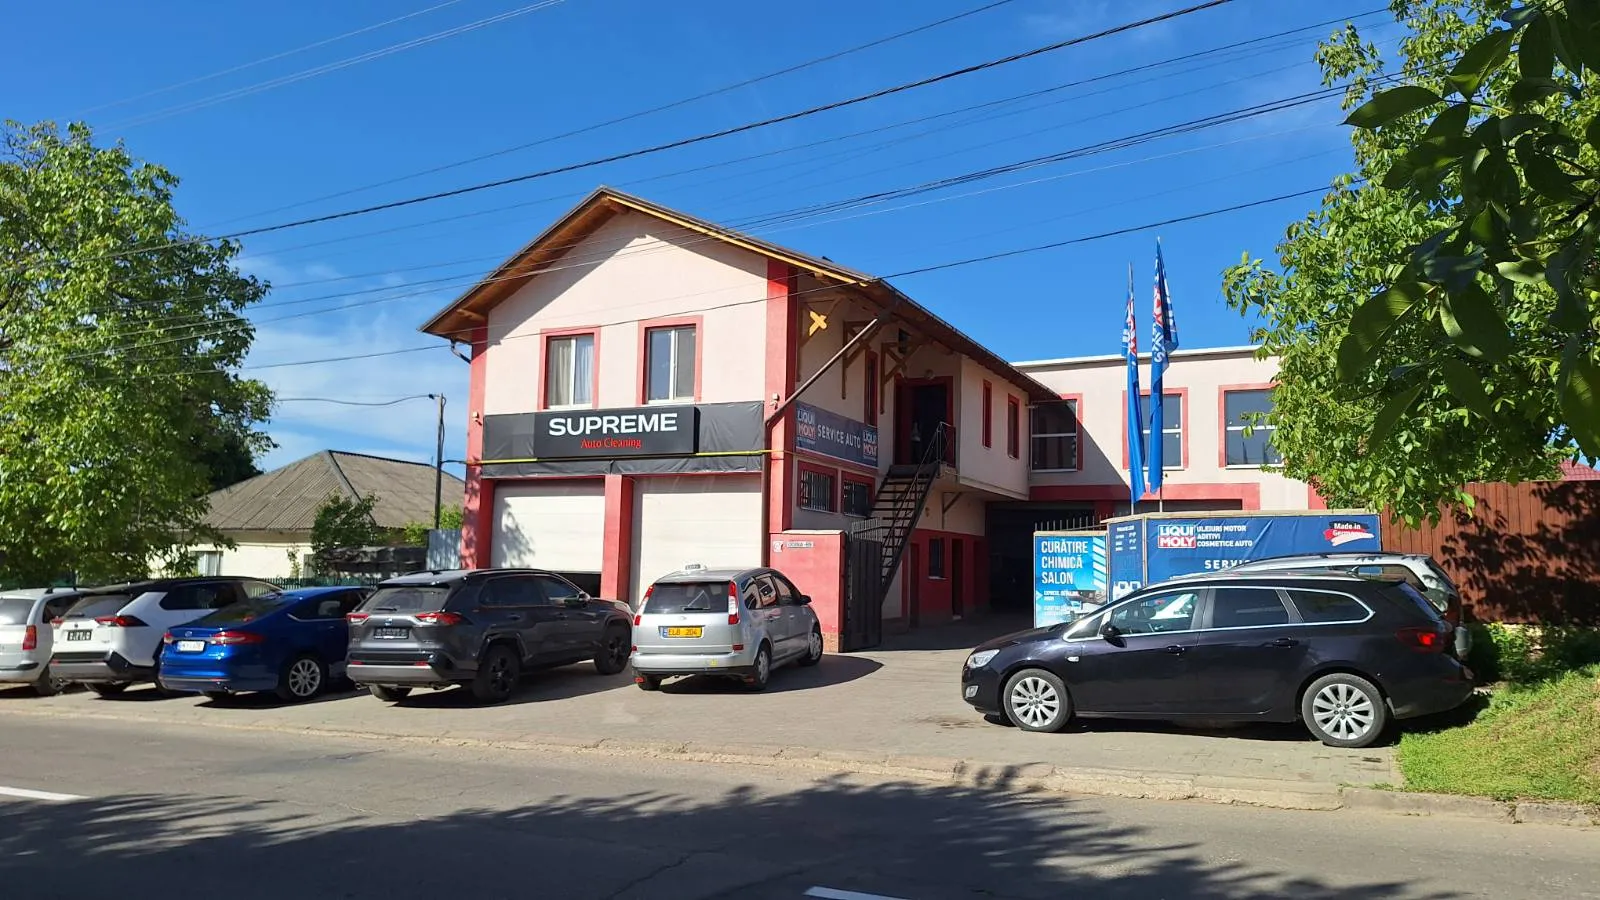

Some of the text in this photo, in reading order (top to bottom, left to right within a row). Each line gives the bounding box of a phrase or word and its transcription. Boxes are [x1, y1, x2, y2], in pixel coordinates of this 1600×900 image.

[797, 409, 815, 425] LIQUI
[548, 413, 678, 436] SUPREME
[798, 423, 816, 439] MOLY
[580, 437, 642, 450] Auto Cleaning
[817, 425, 845, 445] SERVICE
[845, 433, 861, 449] AUTO
[1160, 526, 1194, 536] LIQUI
[1334, 522, 1361, 530] Made in
[1160, 537, 1195, 548] MOLY
[1041, 555, 1083, 569] CHIMICĂ
[1041, 572, 1073, 585] SALON
